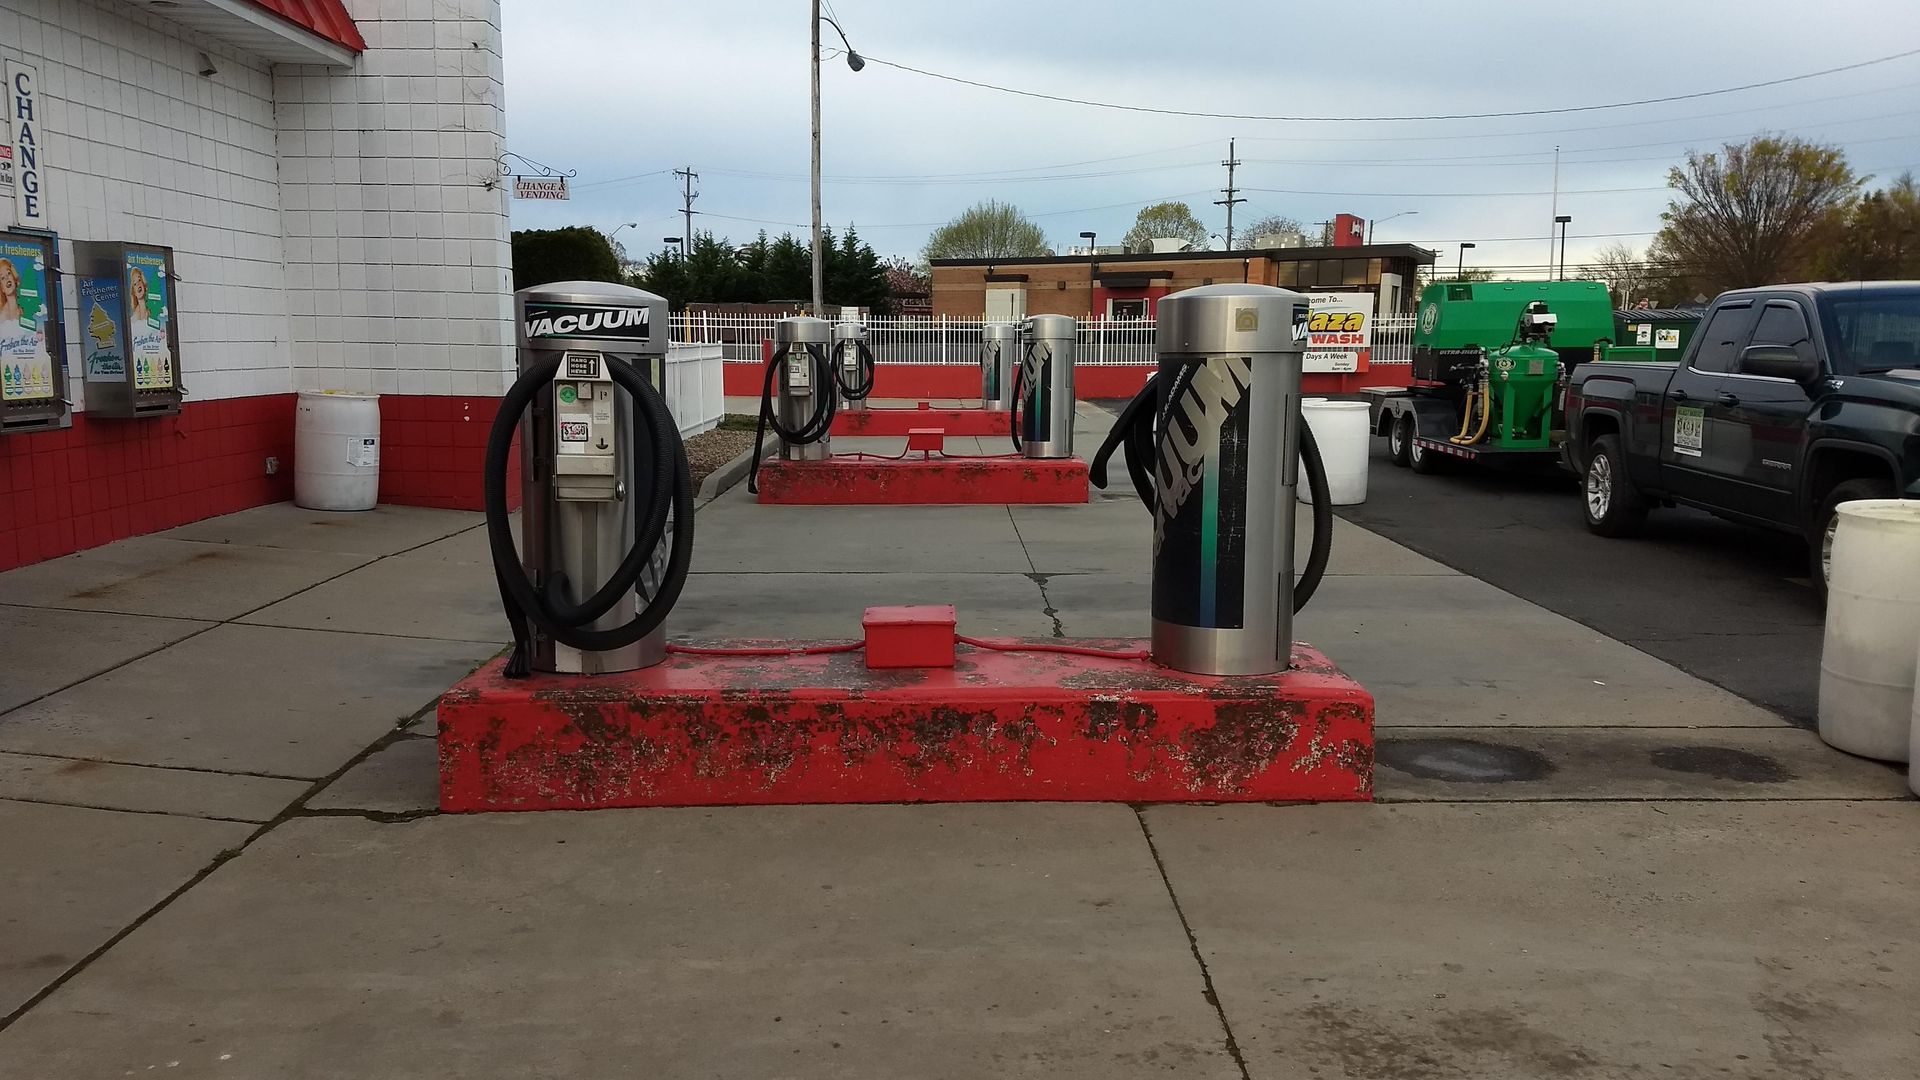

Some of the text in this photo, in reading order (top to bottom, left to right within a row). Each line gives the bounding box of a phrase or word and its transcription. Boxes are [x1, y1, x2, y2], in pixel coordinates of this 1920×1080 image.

[14, 72, 40, 218] CHANGE
[516, 182, 566, 191] CHANGE &
[520, 190, 563, 199] VENDING
[5, 243, 42, 256] fresheners
[83, 280, 94, 288] Air
[82, 285, 118, 296] Freshener
[95, 292, 119, 302] Center
[524, 307, 650, 338] VACUUM
[1311, 333, 1364, 344] WASH
[1306, 352, 1322, 360] Days
